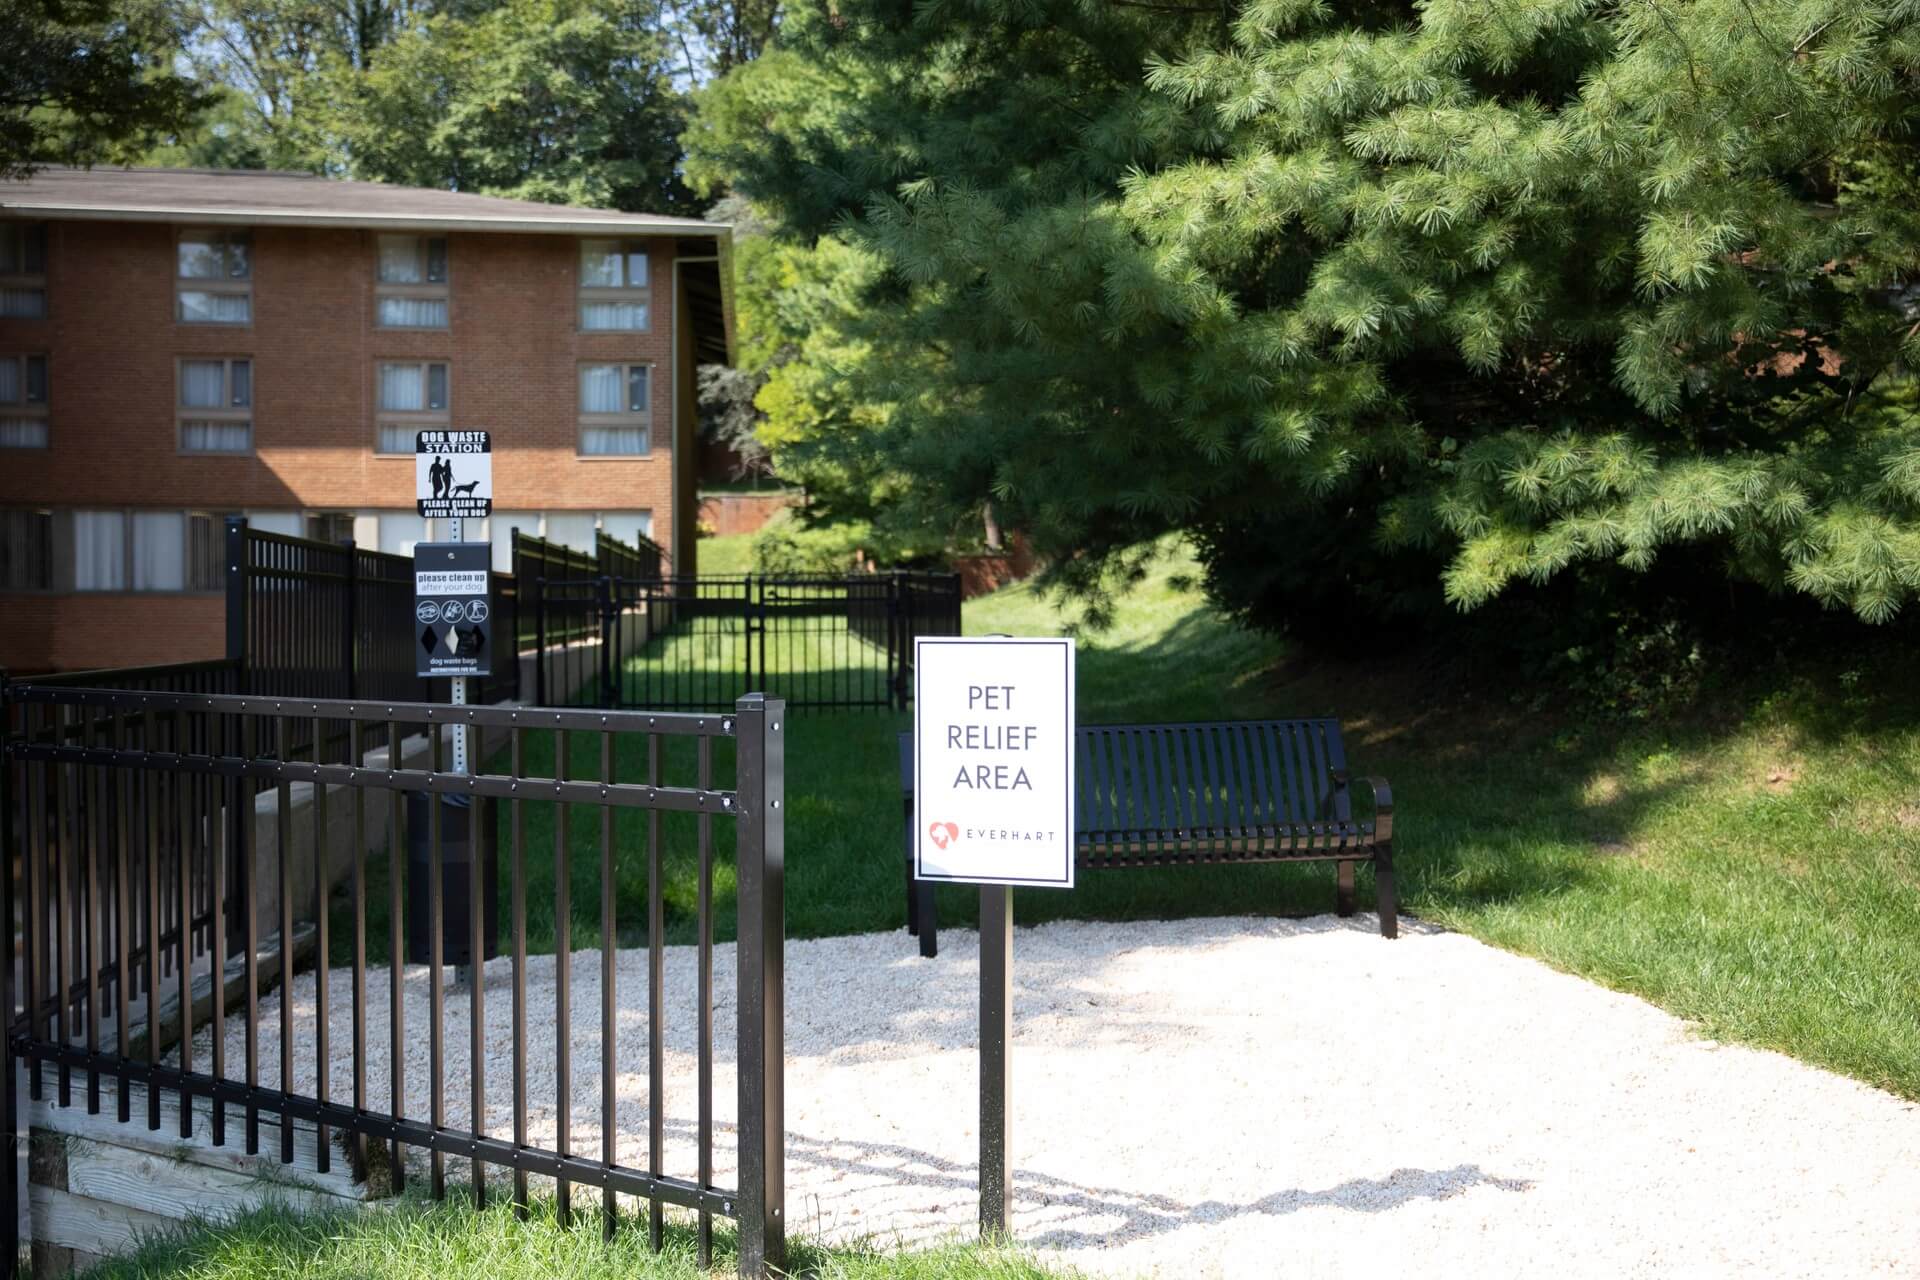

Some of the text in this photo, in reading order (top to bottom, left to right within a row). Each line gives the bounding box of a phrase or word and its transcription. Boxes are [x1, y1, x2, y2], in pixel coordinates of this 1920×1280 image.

[421, 431, 486, 442] DOG WASTE
[425, 444, 482, 453] STATION
[423, 500, 487, 508] PLEASE CLEAN UP
[424, 509, 486, 517] AFTER YOUR DOG
[418, 573, 485, 583] please clean up
[443, 584, 463, 592] your
[465, 582, 482, 592] dog
[430, 657, 442, 665] dog
[462, 657, 477, 665] bags
[968, 685, 1016, 711] PET
[948, 725, 1038, 751] RELIEF
[953, 765, 1033, 790] AREA
[967, 829, 1055, 841] EVERHART
